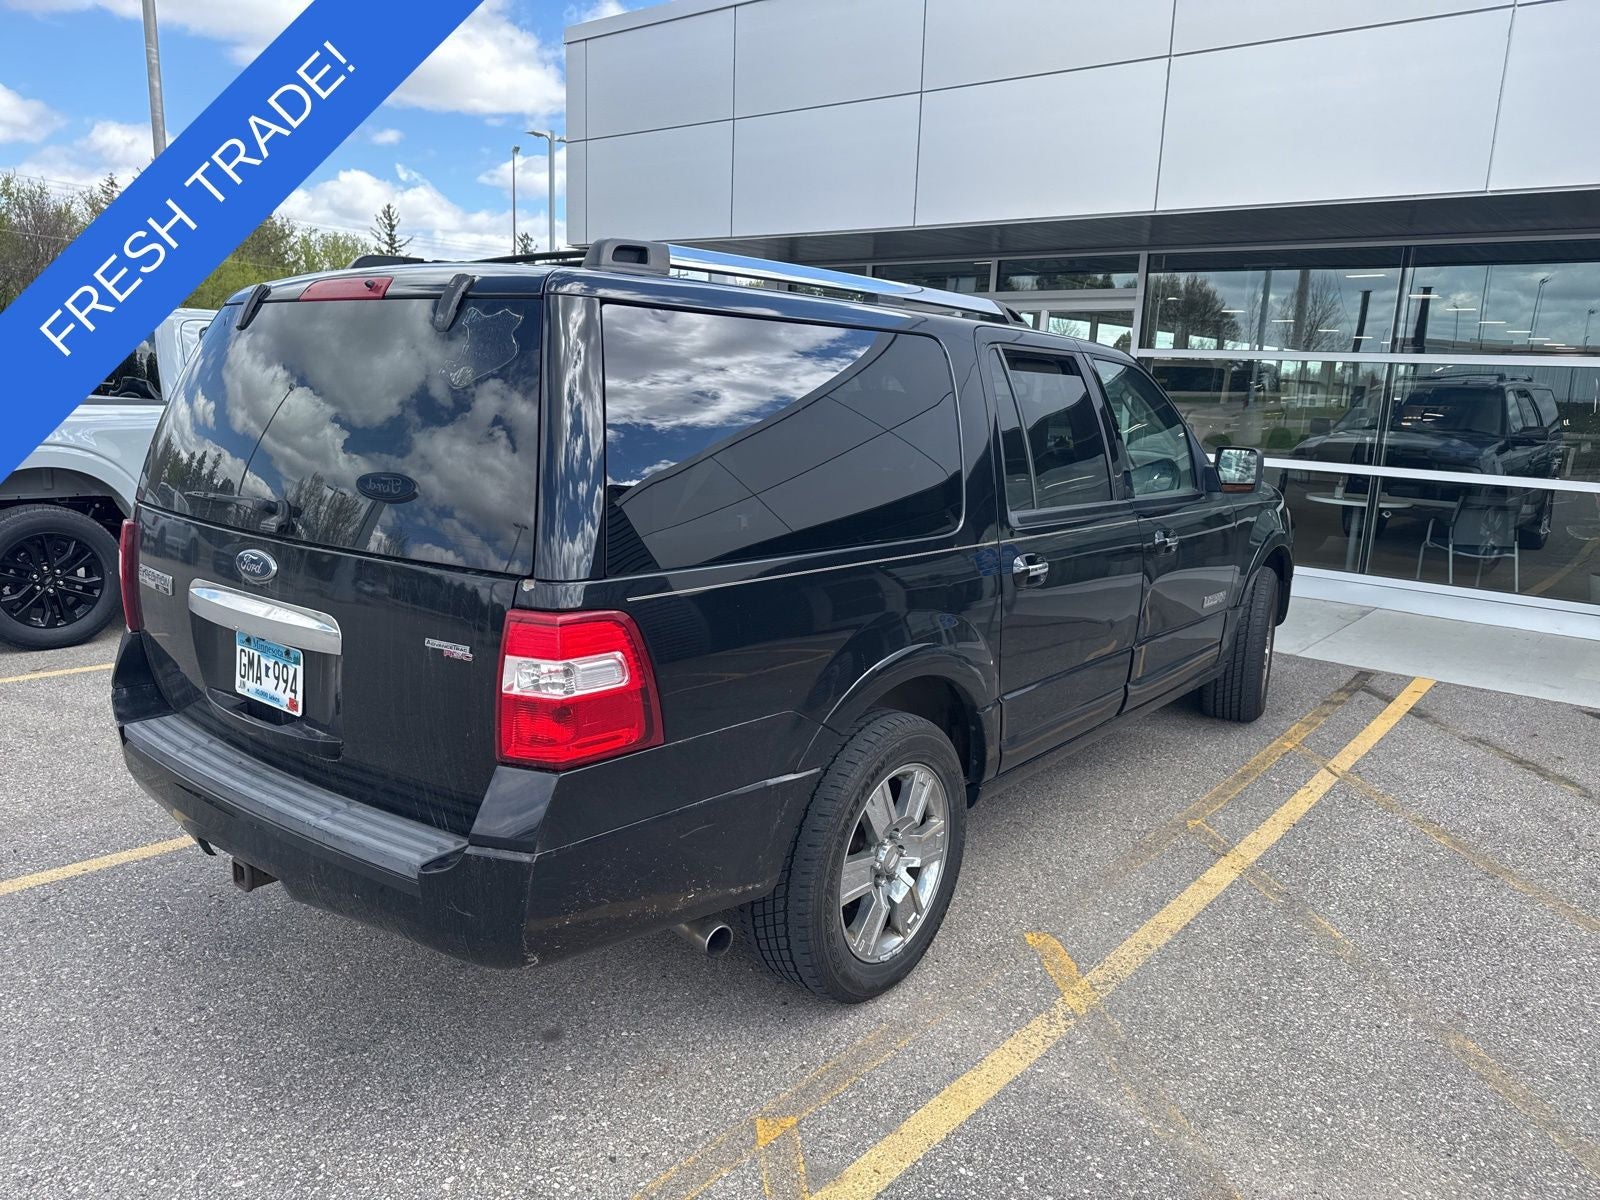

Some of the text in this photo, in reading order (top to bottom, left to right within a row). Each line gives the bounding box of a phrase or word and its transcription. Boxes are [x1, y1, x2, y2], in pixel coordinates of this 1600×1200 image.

[241, 553, 263, 574] Ford
[252, 639, 284, 658] Minnesota
[239, 648, 298, 700] GMA 994
